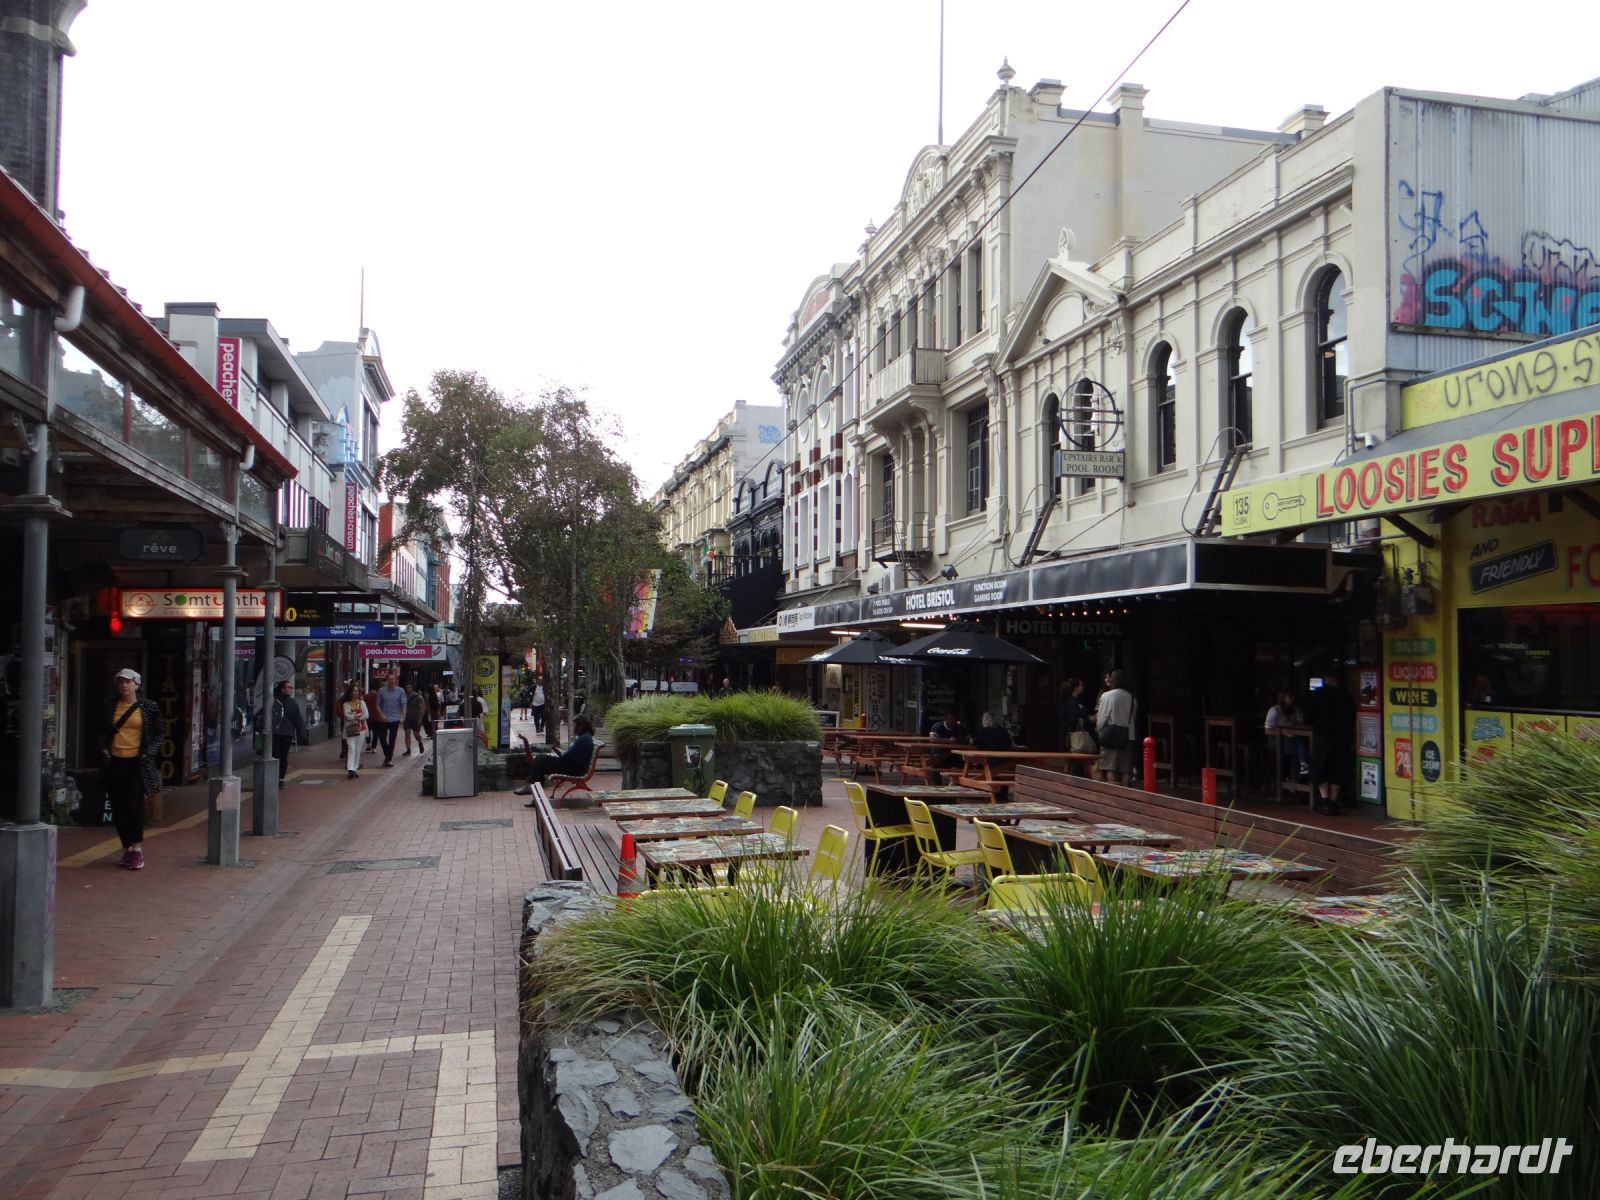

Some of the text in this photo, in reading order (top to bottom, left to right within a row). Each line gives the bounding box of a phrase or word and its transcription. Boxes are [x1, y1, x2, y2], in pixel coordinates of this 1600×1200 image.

[1063, 452, 1098, 462] UPSTAIRS
[1099, 454, 1114, 463] BAR
[1066, 463, 1119, 474] POOL ROOM
[1317, 443, 1468, 518] LOOSIES
[1234, 496, 1249, 516] 135
[143, 543, 177, 553] rêve
[1470, 538, 1500, 560] AND
[1479, 550, 1545, 584] FRIENDLY
[974, 580, 1006, 592] FUNCTION ROOM
[905, 589, 955, 610] HOTEL BRISTOL
[974, 591, 1003, 603] GAMING ROOM
[1006, 619, 1123, 636] HOTEL BRISTOL
[1393, 665, 1435, 679] LIQUOR
[1395, 690, 1429, 704] WINE
[159, 650, 176, 779] TATTOO
[1391, 715, 1434, 731] BURGERS
[1396, 751, 1411, 769] 24
[1424, 750, 1435, 760] ICE
[1422, 760, 1440, 770] CREAM
